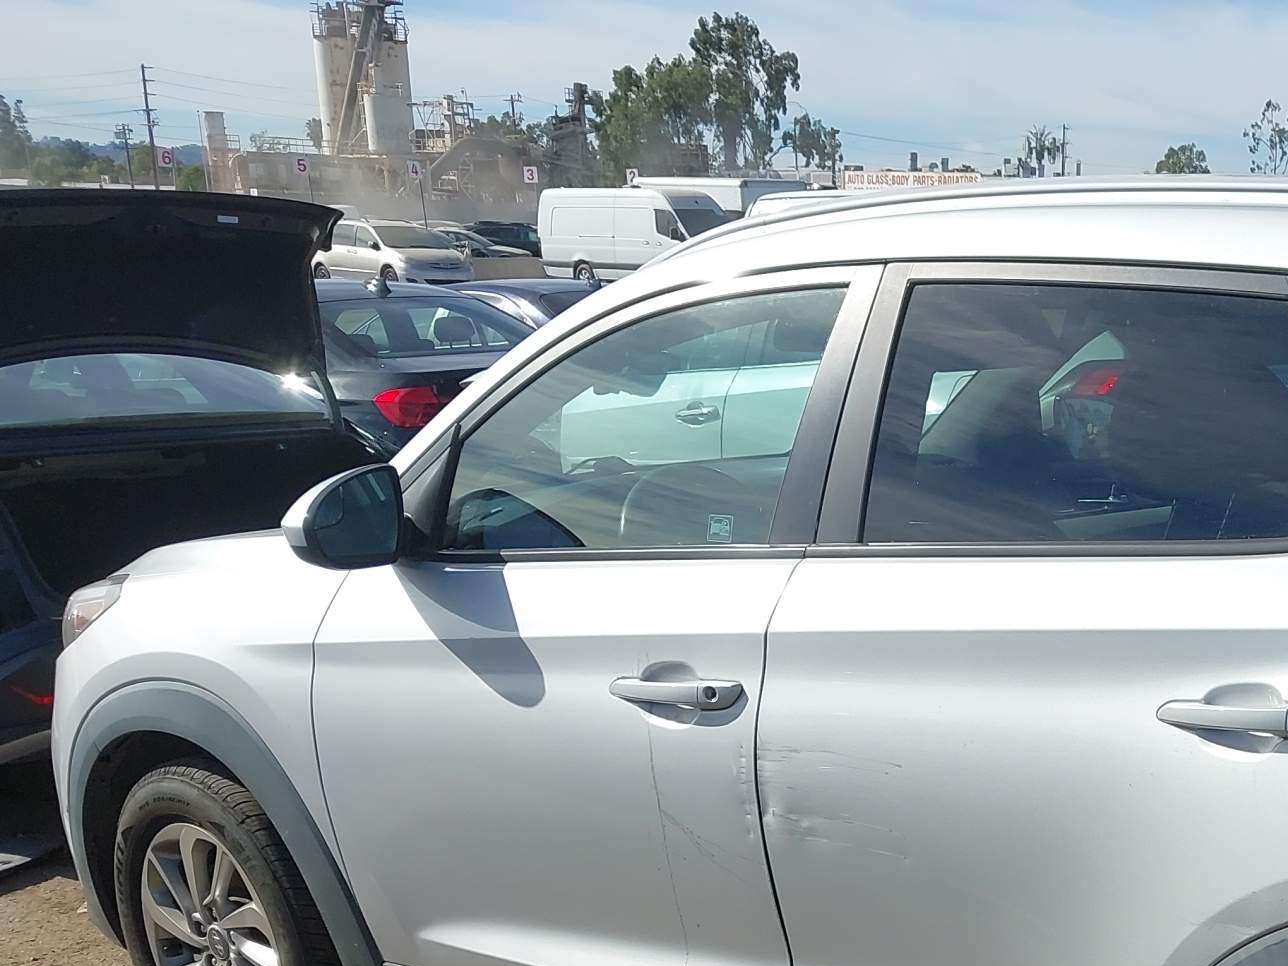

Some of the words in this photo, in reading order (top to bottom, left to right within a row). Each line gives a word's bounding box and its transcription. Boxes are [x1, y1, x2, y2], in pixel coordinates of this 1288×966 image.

[160, 149, 173, 167] 6
[296, 158, 308, 174] 5
[410, 161, 420, 177] 4
[525, 167, 536, 181] 3
[847, 174, 865, 185] AUTO
